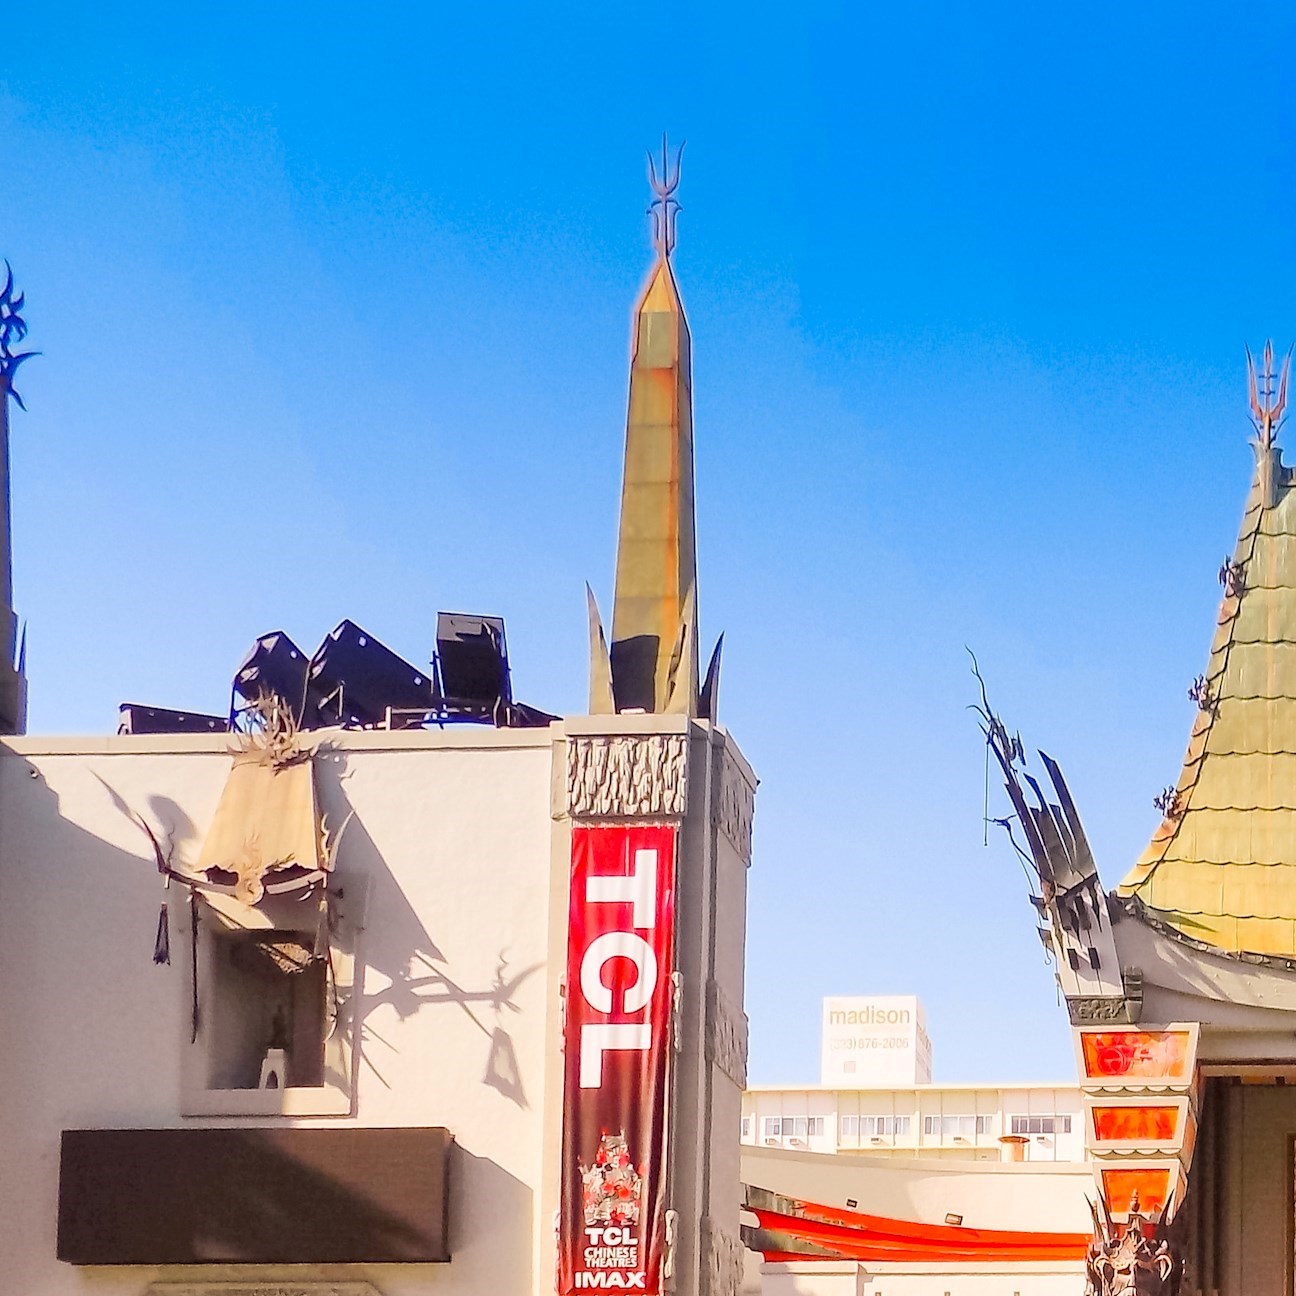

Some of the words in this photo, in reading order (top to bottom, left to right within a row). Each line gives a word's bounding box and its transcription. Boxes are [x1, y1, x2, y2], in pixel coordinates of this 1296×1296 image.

[580, 849, 657, 1088] TCL
[829, 1005, 910, 1024] madison
[584, 1226, 638, 1246] TCL
[584, 1247, 637, 1259] CHINESE
[584, 1257, 637, 1268] THEATRES
[574, 1271, 646, 1288] IMAX
